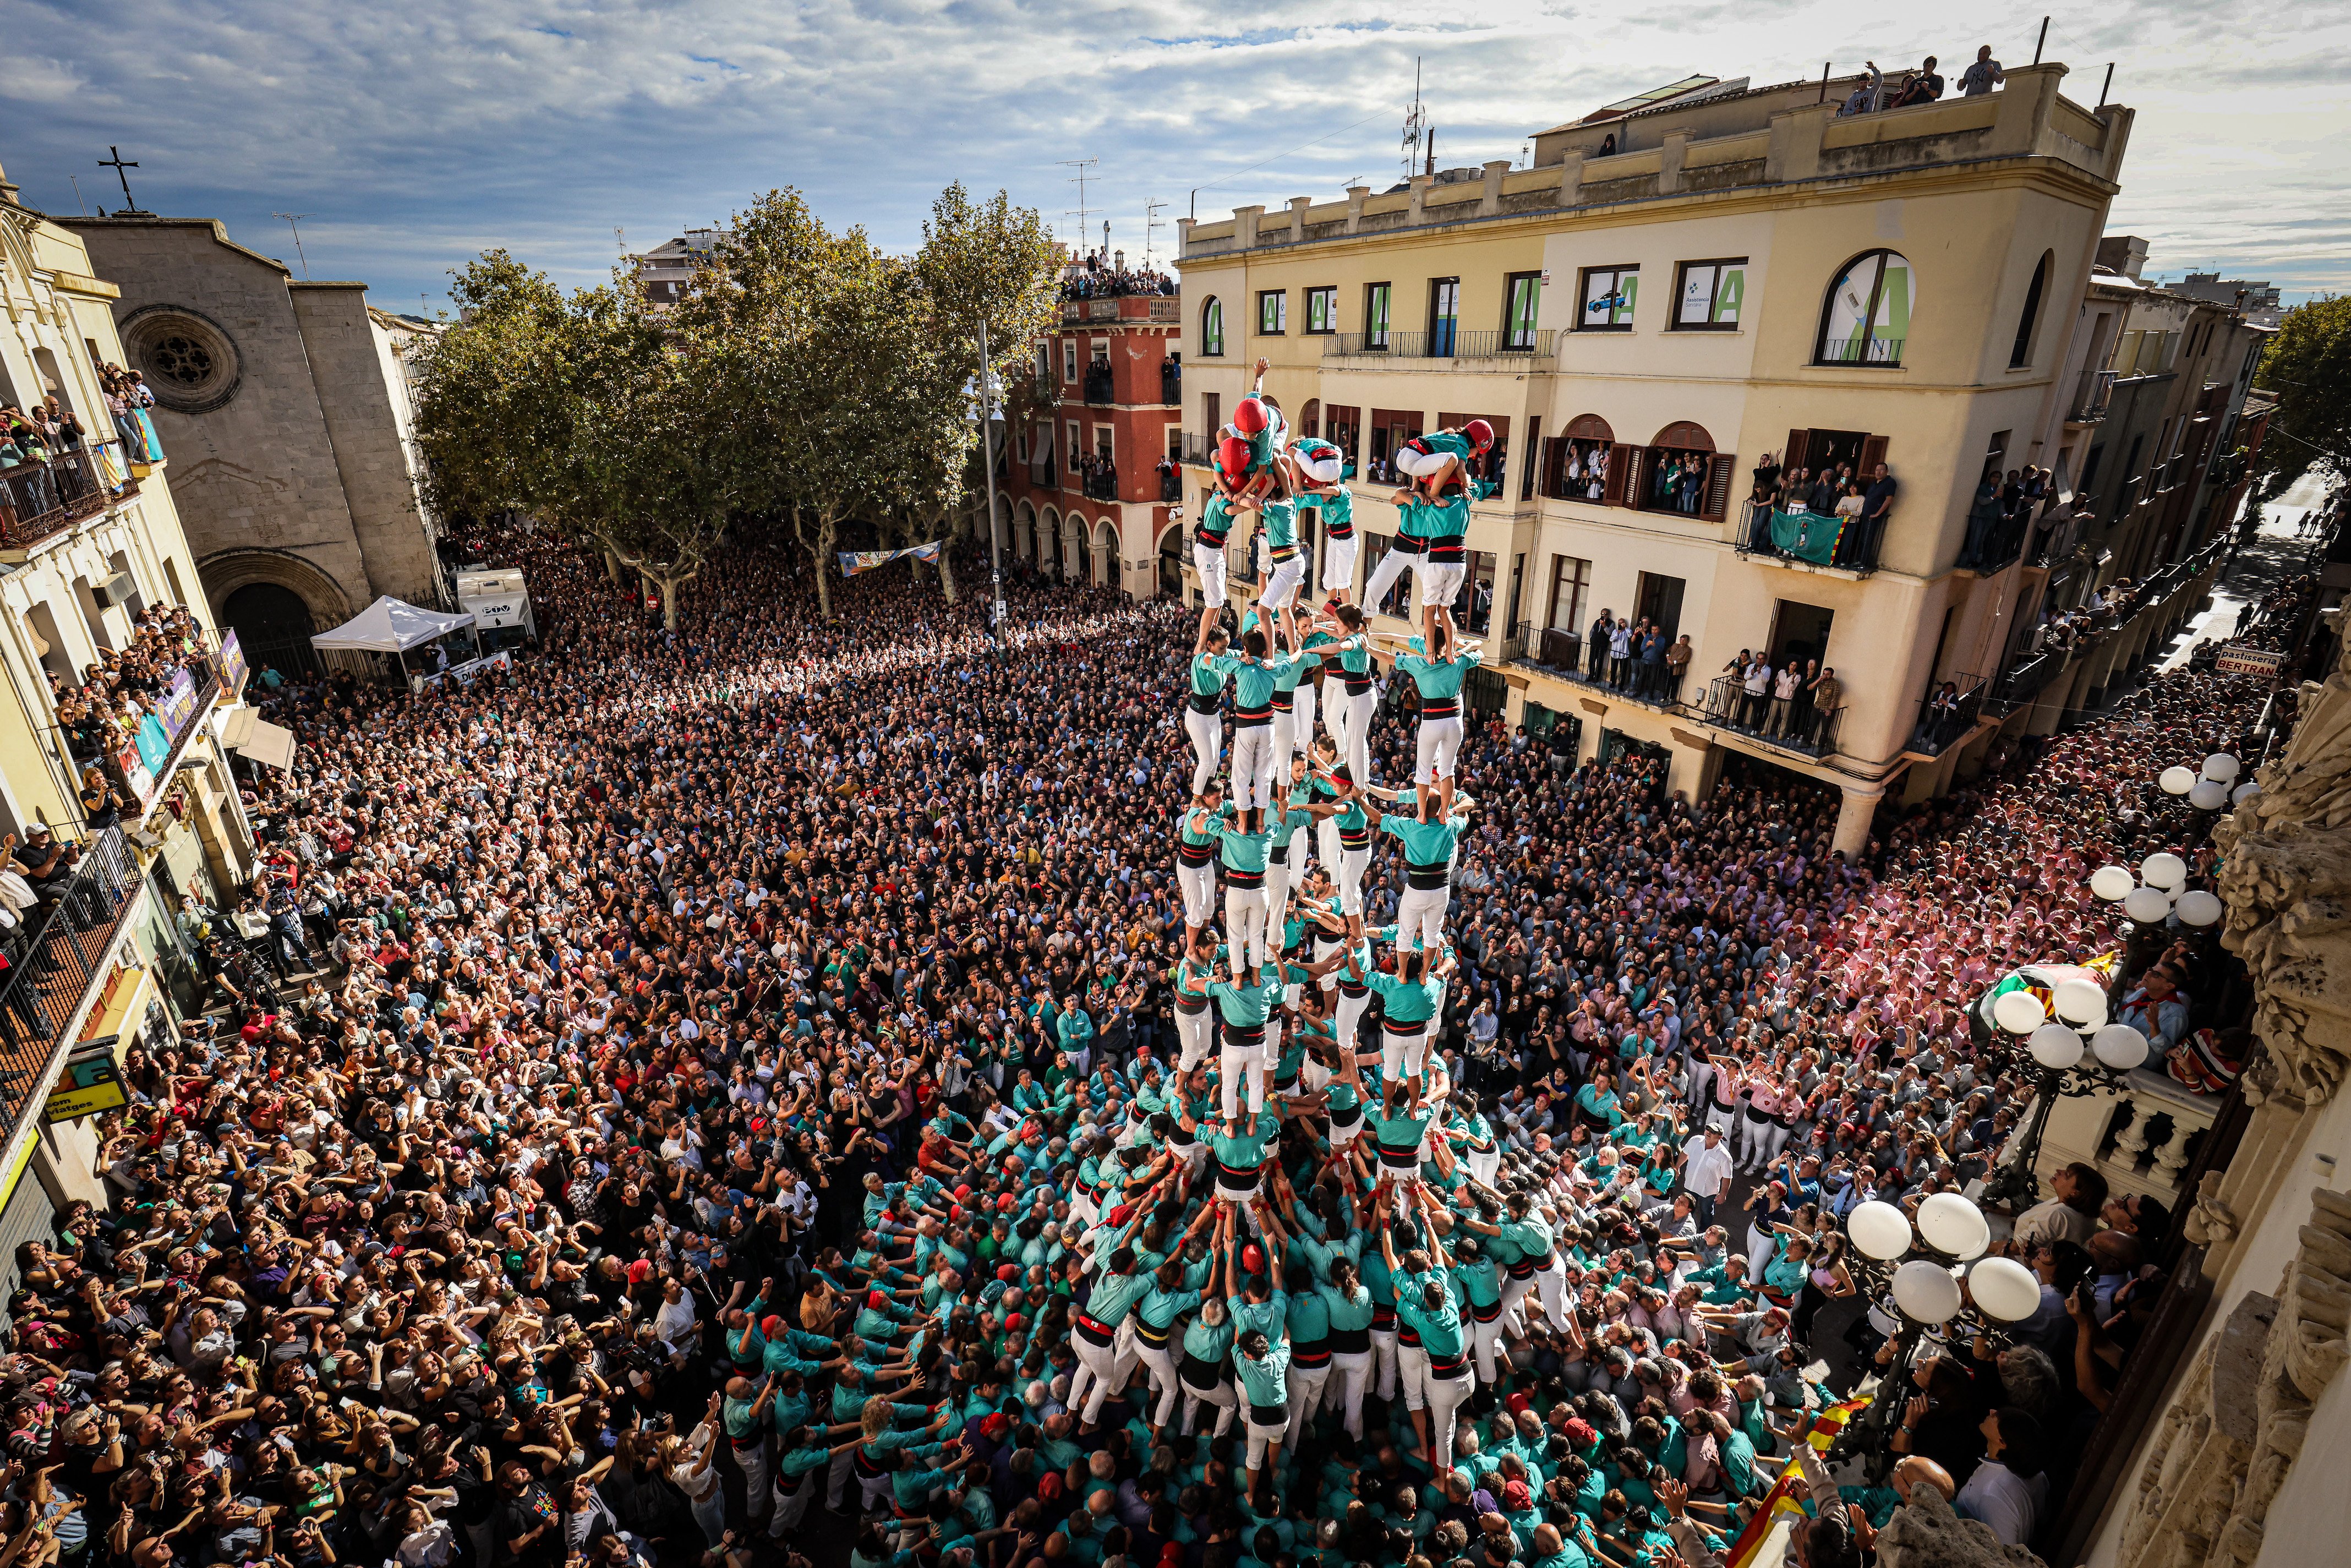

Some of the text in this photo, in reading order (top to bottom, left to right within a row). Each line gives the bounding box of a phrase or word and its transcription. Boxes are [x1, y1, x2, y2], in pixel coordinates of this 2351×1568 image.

[1613, 276, 1638, 323] A
[1713, 270, 1744, 322] A
[1264, 298, 1276, 330] A
[1311, 295, 1325, 330] A
[1840, 267, 1909, 362] A
[483, 605, 510, 614] PTV
[2221, 651, 2277, 665] pastisseria
[2217, 660, 2275, 676] BERTRAN
[80, 1024, 89, 1037] DE
[45, 1099, 72, 1108] som
[48, 1101, 94, 1116] viatges
